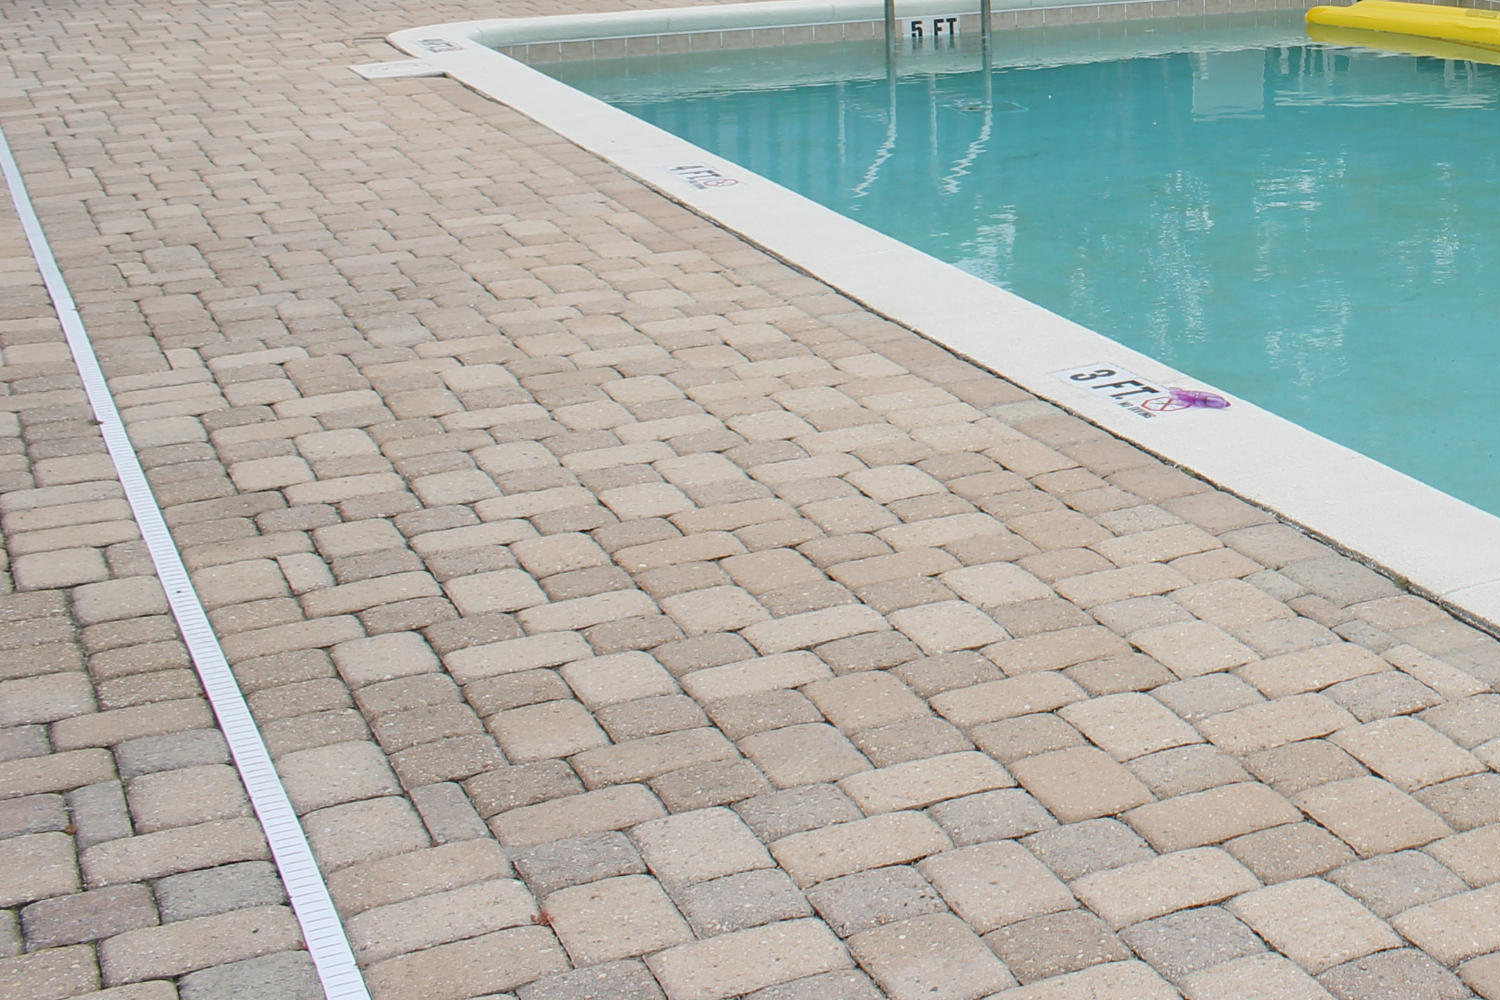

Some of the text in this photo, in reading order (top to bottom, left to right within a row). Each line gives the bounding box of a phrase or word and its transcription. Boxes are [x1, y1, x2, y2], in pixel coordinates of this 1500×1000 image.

[911, 17, 957, 38] 5 FT
[1069, 368, 1117, 382] 3
